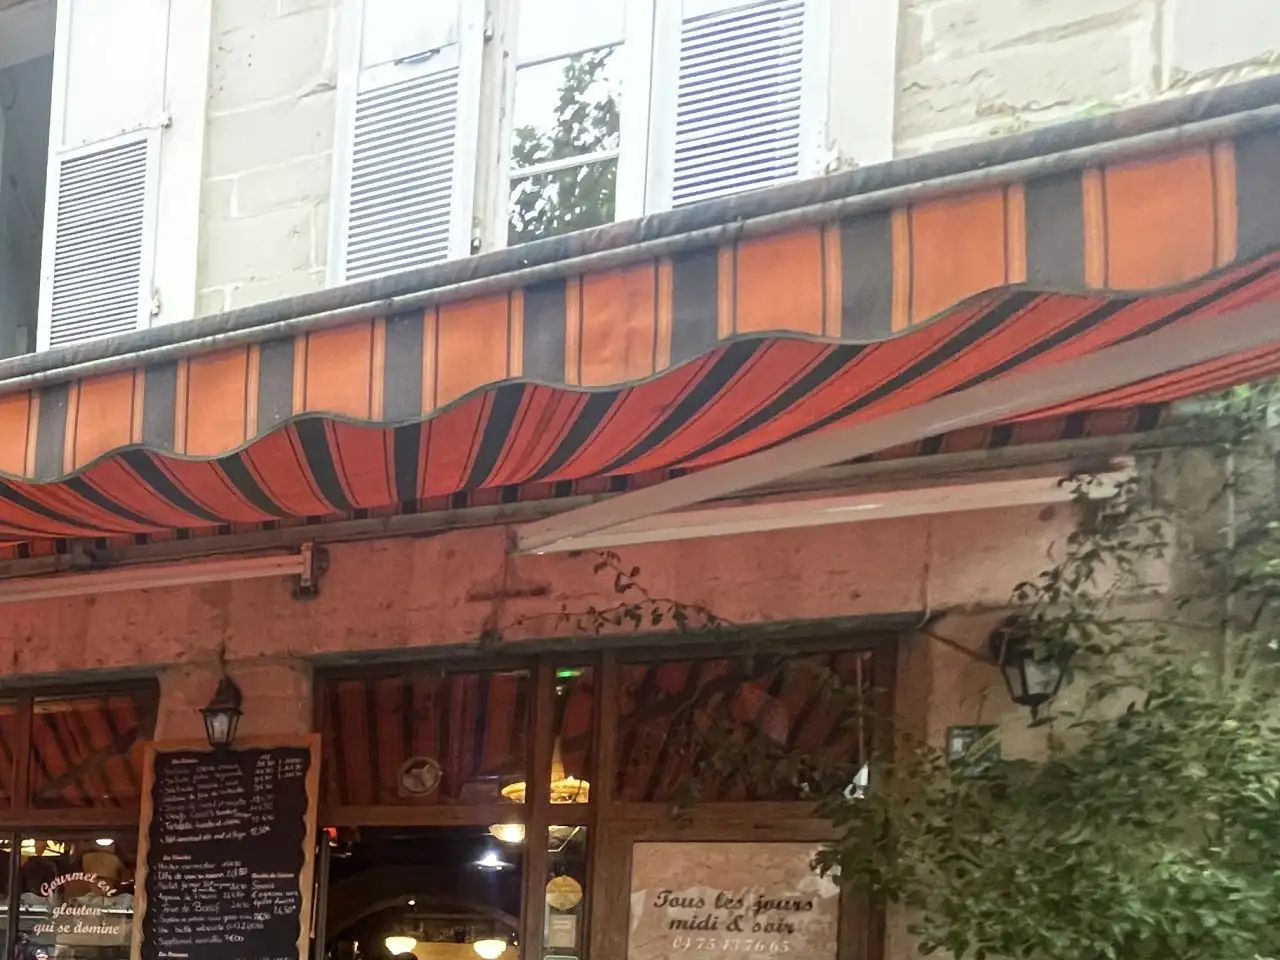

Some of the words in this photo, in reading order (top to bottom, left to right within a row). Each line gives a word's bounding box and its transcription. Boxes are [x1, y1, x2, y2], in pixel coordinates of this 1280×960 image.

[40, 871, 98, 900] Gourmet
[52, 902, 102, 919] glouton
[653, 889, 706, 909] Tous
[714, 891, 745, 910] les
[751, 895, 814, 917] jours
[33, 921, 55, 936] qui
[57, 923, 71, 934] se
[73, 920, 121, 935] domine
[668, 913, 720, 932] midi
[725, 915, 745, 933] &
[751, 919, 797, 935] soir
